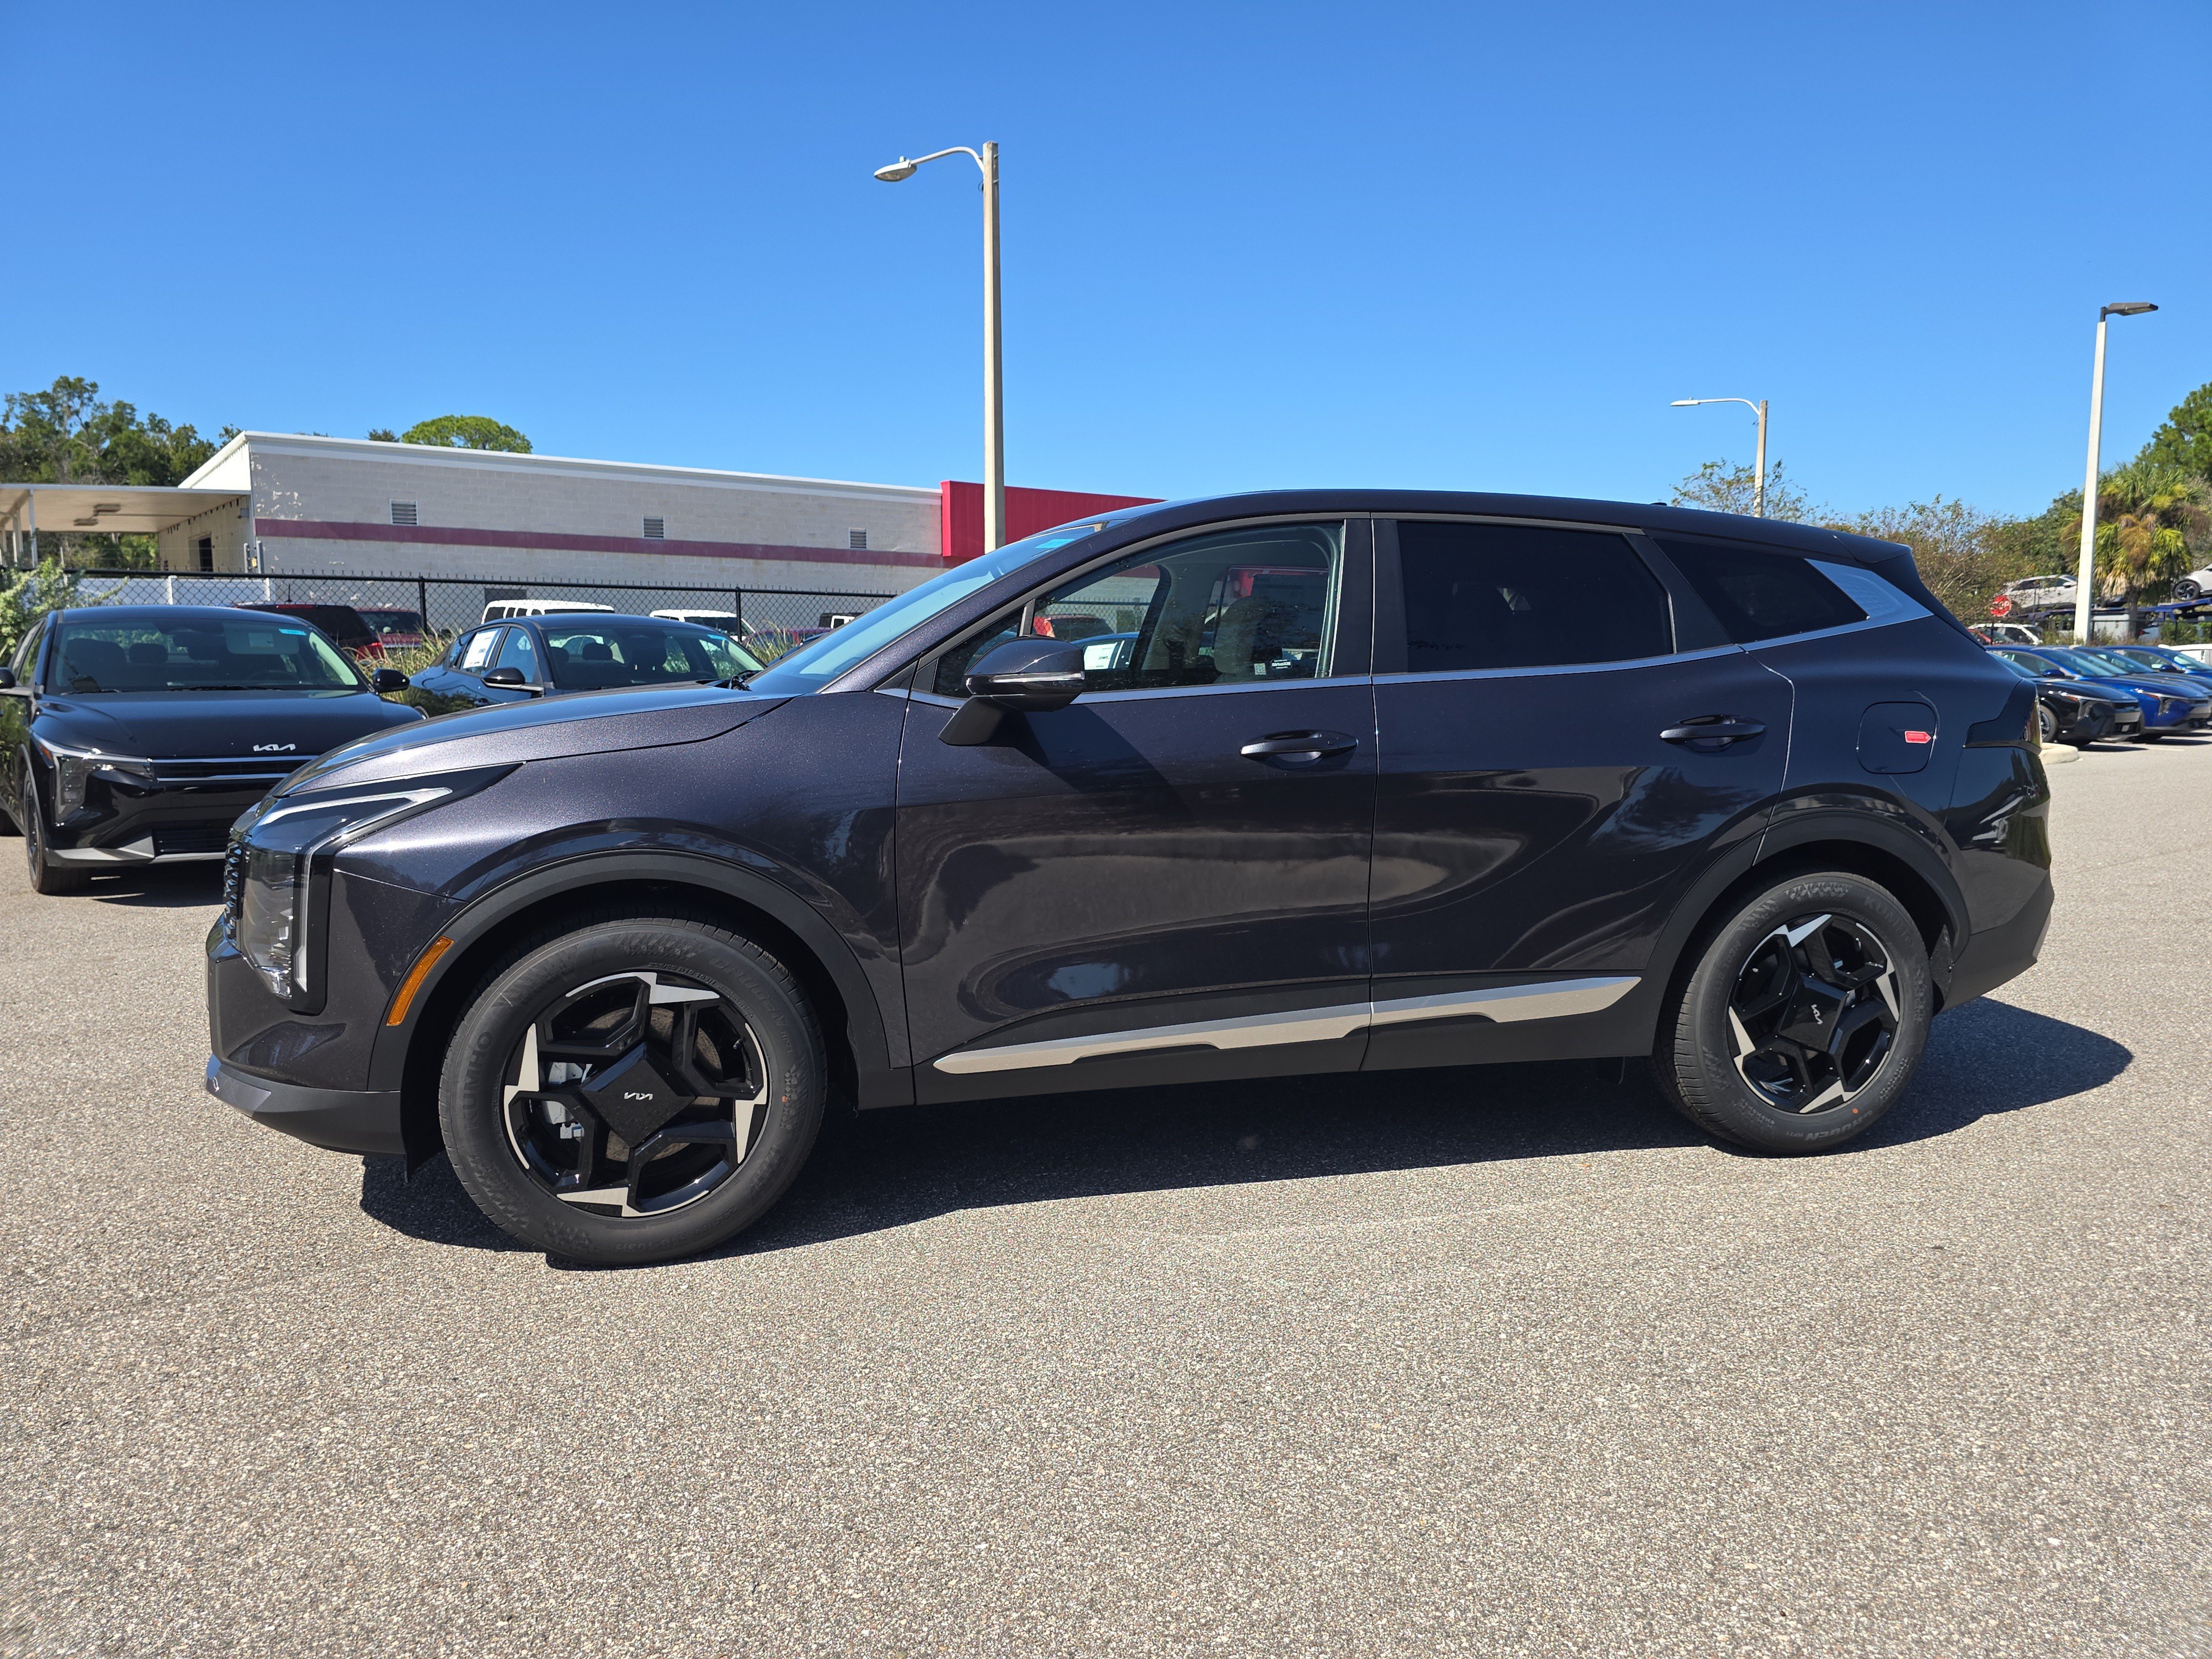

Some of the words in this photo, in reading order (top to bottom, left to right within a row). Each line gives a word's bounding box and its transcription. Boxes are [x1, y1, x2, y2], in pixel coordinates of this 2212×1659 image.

[253, 743, 296, 751] KIA
[1811, 1004, 1823, 1025] KIA
[463, 1031, 493, 1130] KUMHO
[624, 1092, 653, 1100] KIA
[616, 1242, 654, 1251] 103H
